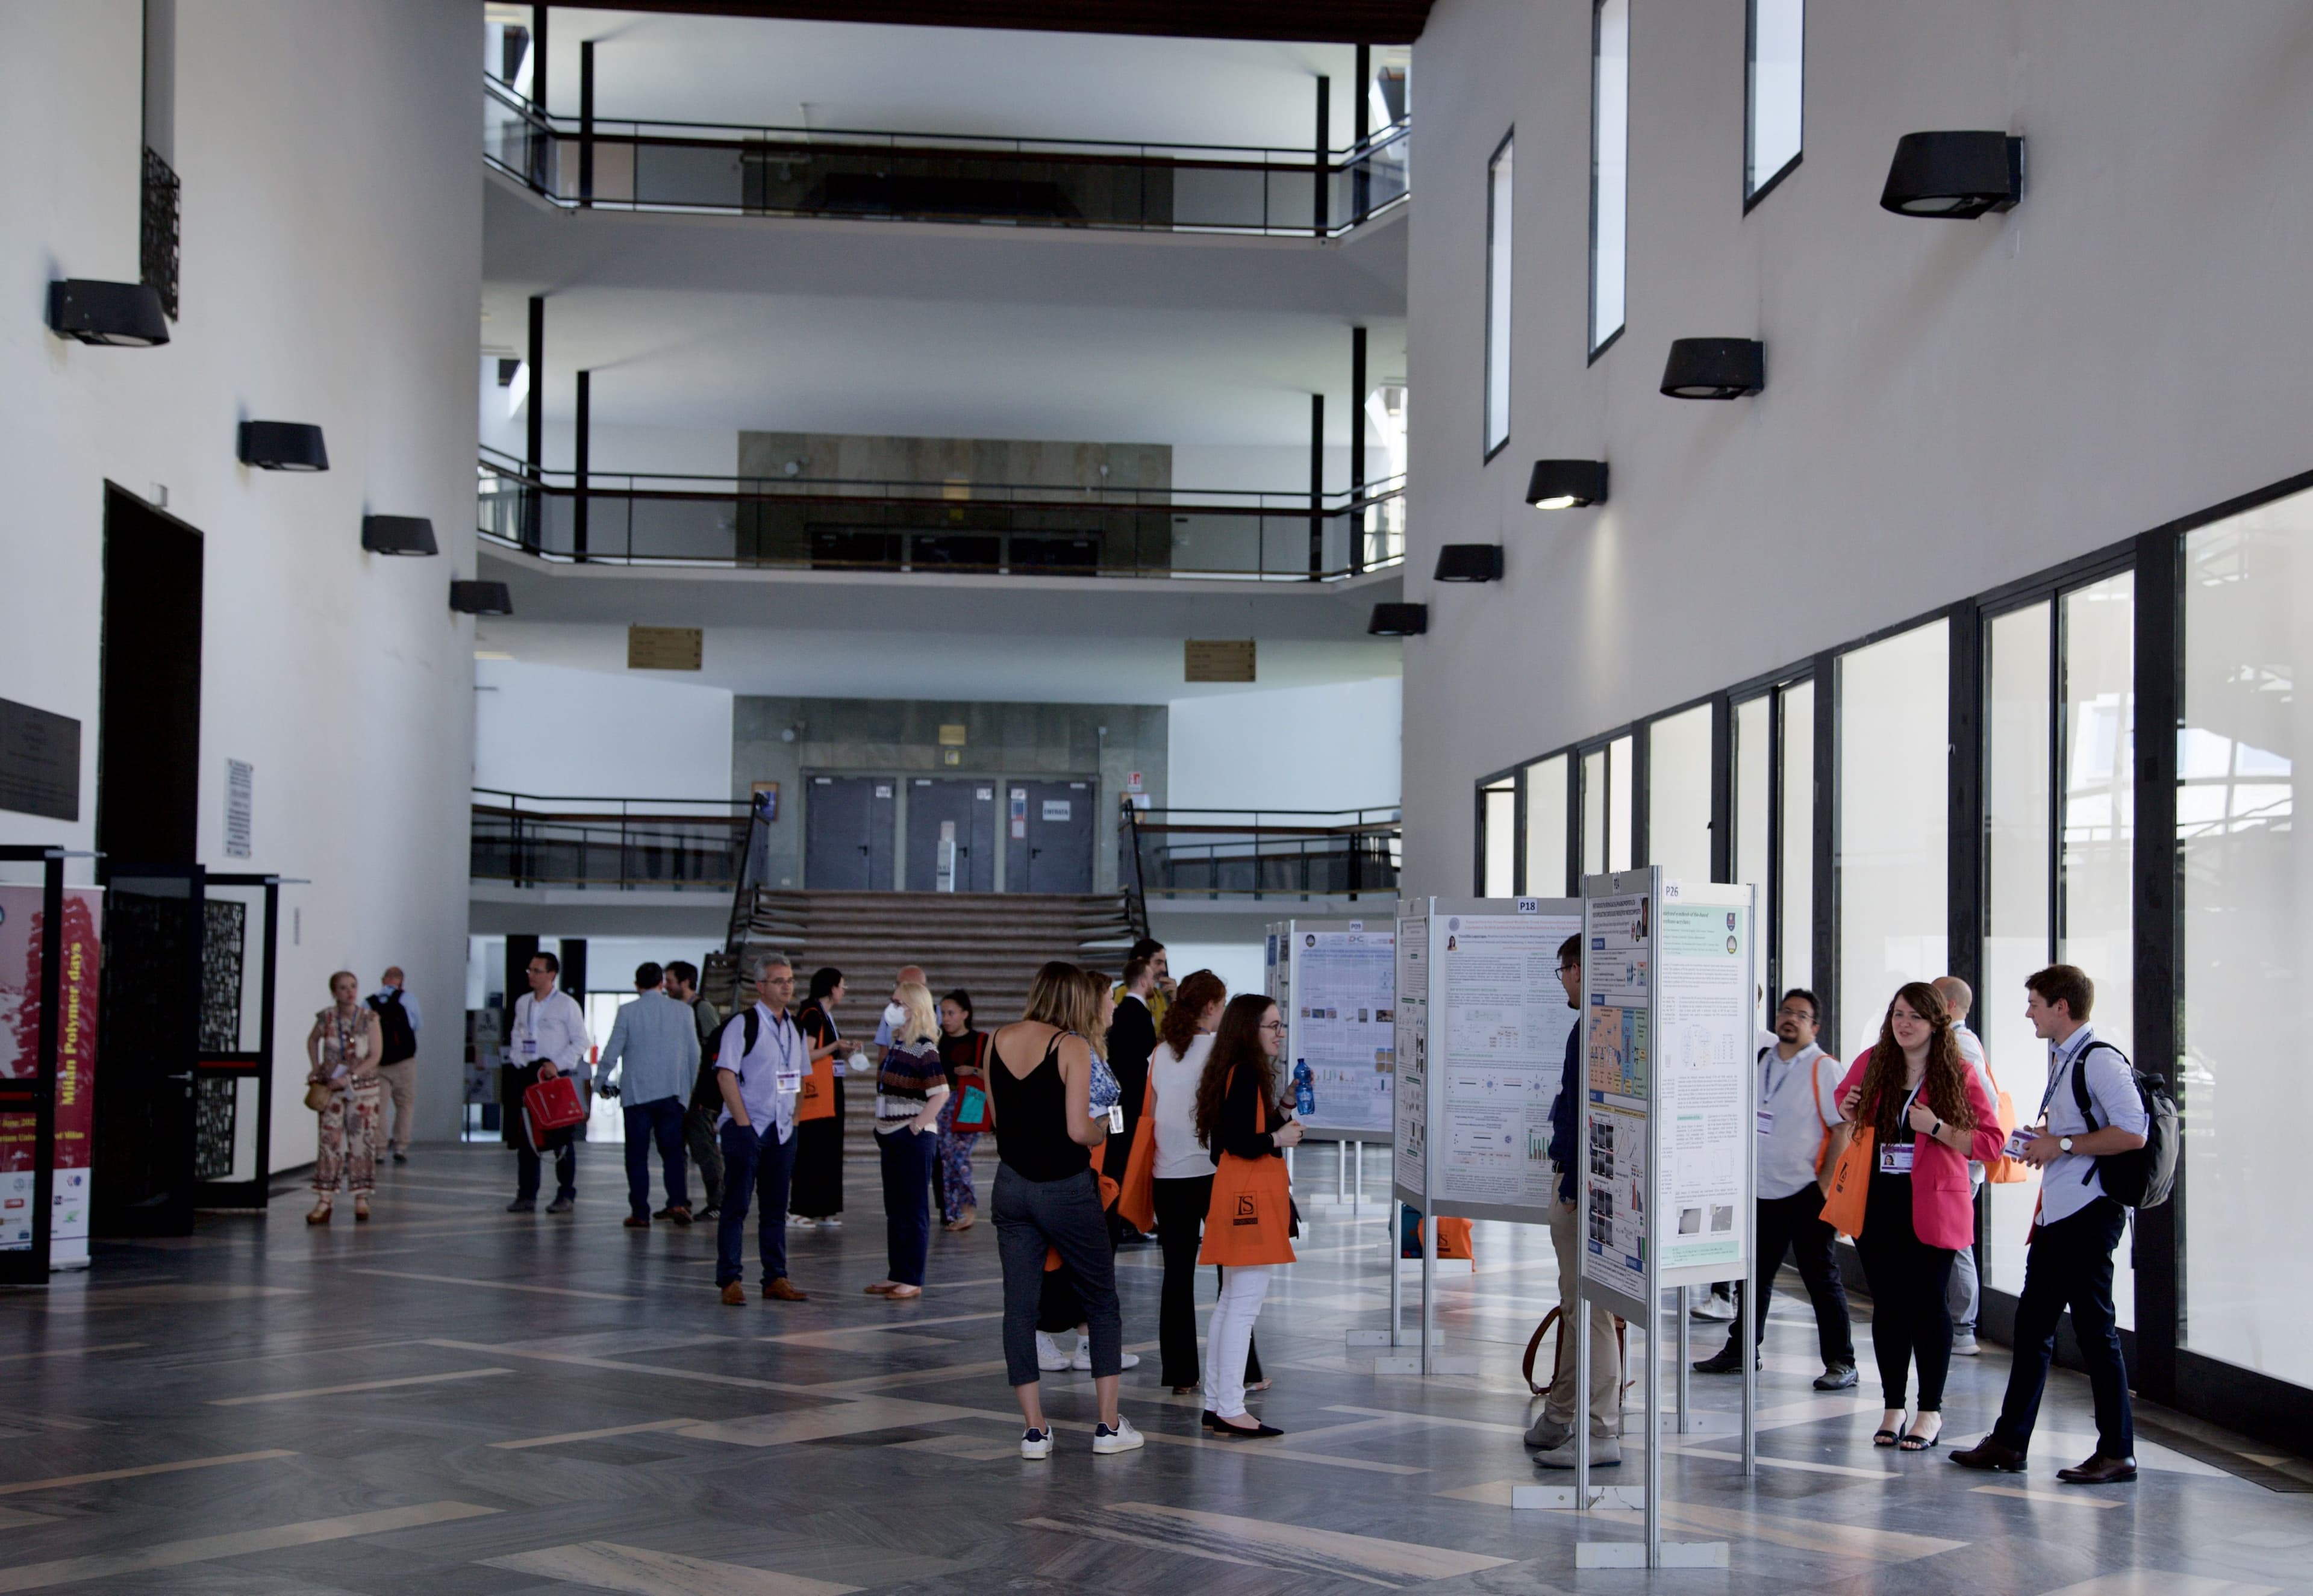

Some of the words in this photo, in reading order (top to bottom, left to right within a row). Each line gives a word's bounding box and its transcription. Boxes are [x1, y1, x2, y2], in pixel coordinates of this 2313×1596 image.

[1665, 886, 1679, 897] P26
[1520, 902, 1535, 911] P18
[67, 942, 83, 980] days
[64, 985, 80, 1055] Polymer
[62, 1059, 76, 1105] Milan
[64, 1130, 85, 1139] Milan
